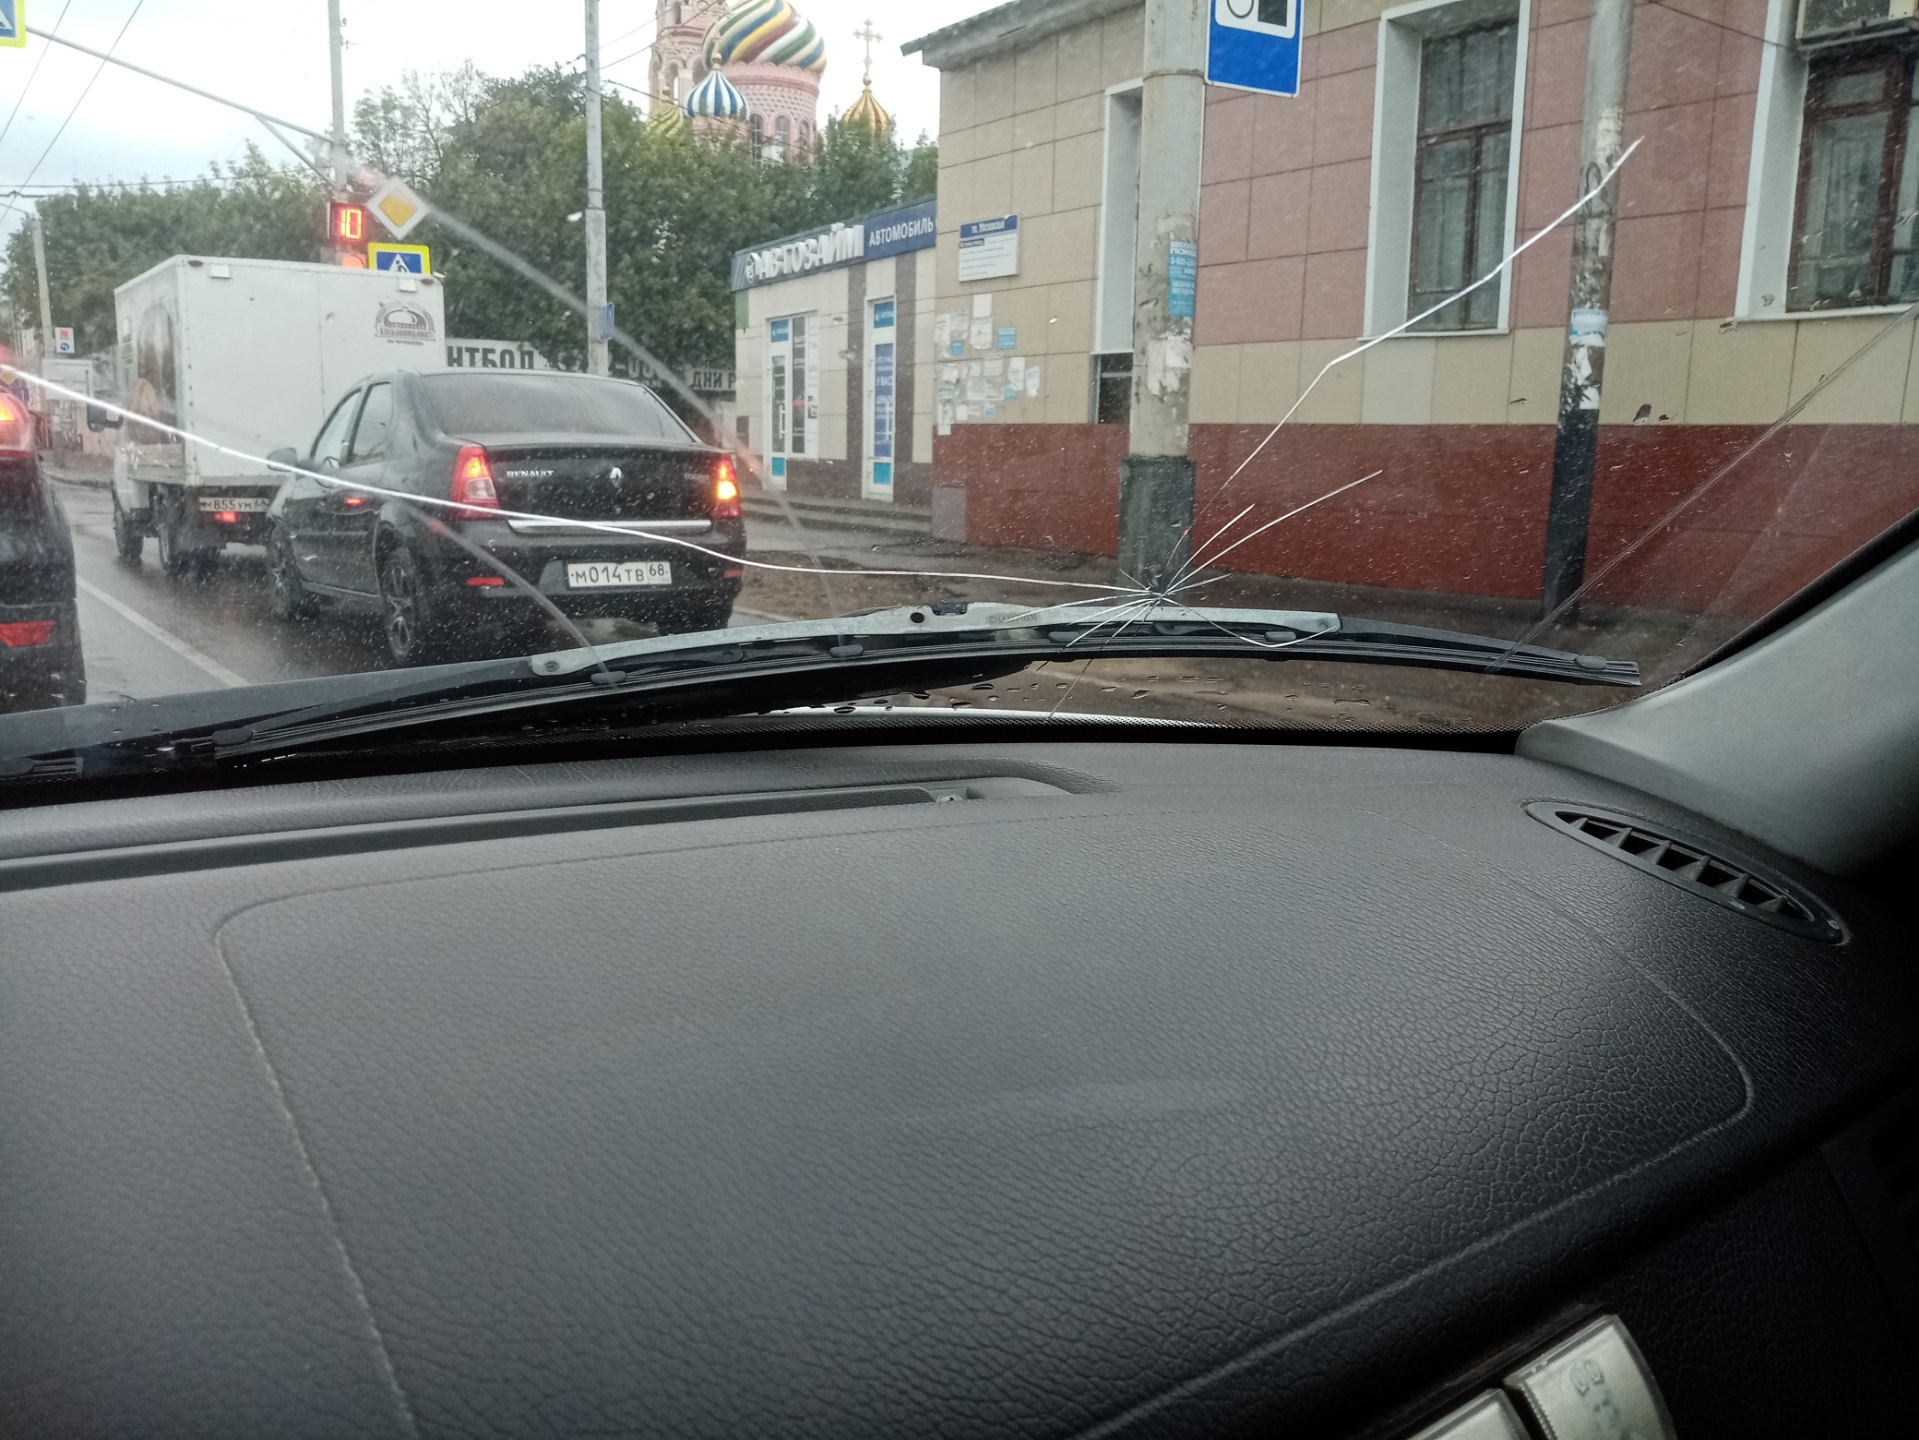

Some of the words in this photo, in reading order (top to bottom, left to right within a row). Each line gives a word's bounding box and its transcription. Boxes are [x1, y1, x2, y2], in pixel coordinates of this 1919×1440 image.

[340, 209, 362, 239] 10
[869, 216, 934, 247] АВТОМОБИЛЬ
[758, 222, 865, 280] АВТОЗАЙМ
[692, 370, 722, 390] ДНИ
[506, 469, 555, 479] RENAULT
